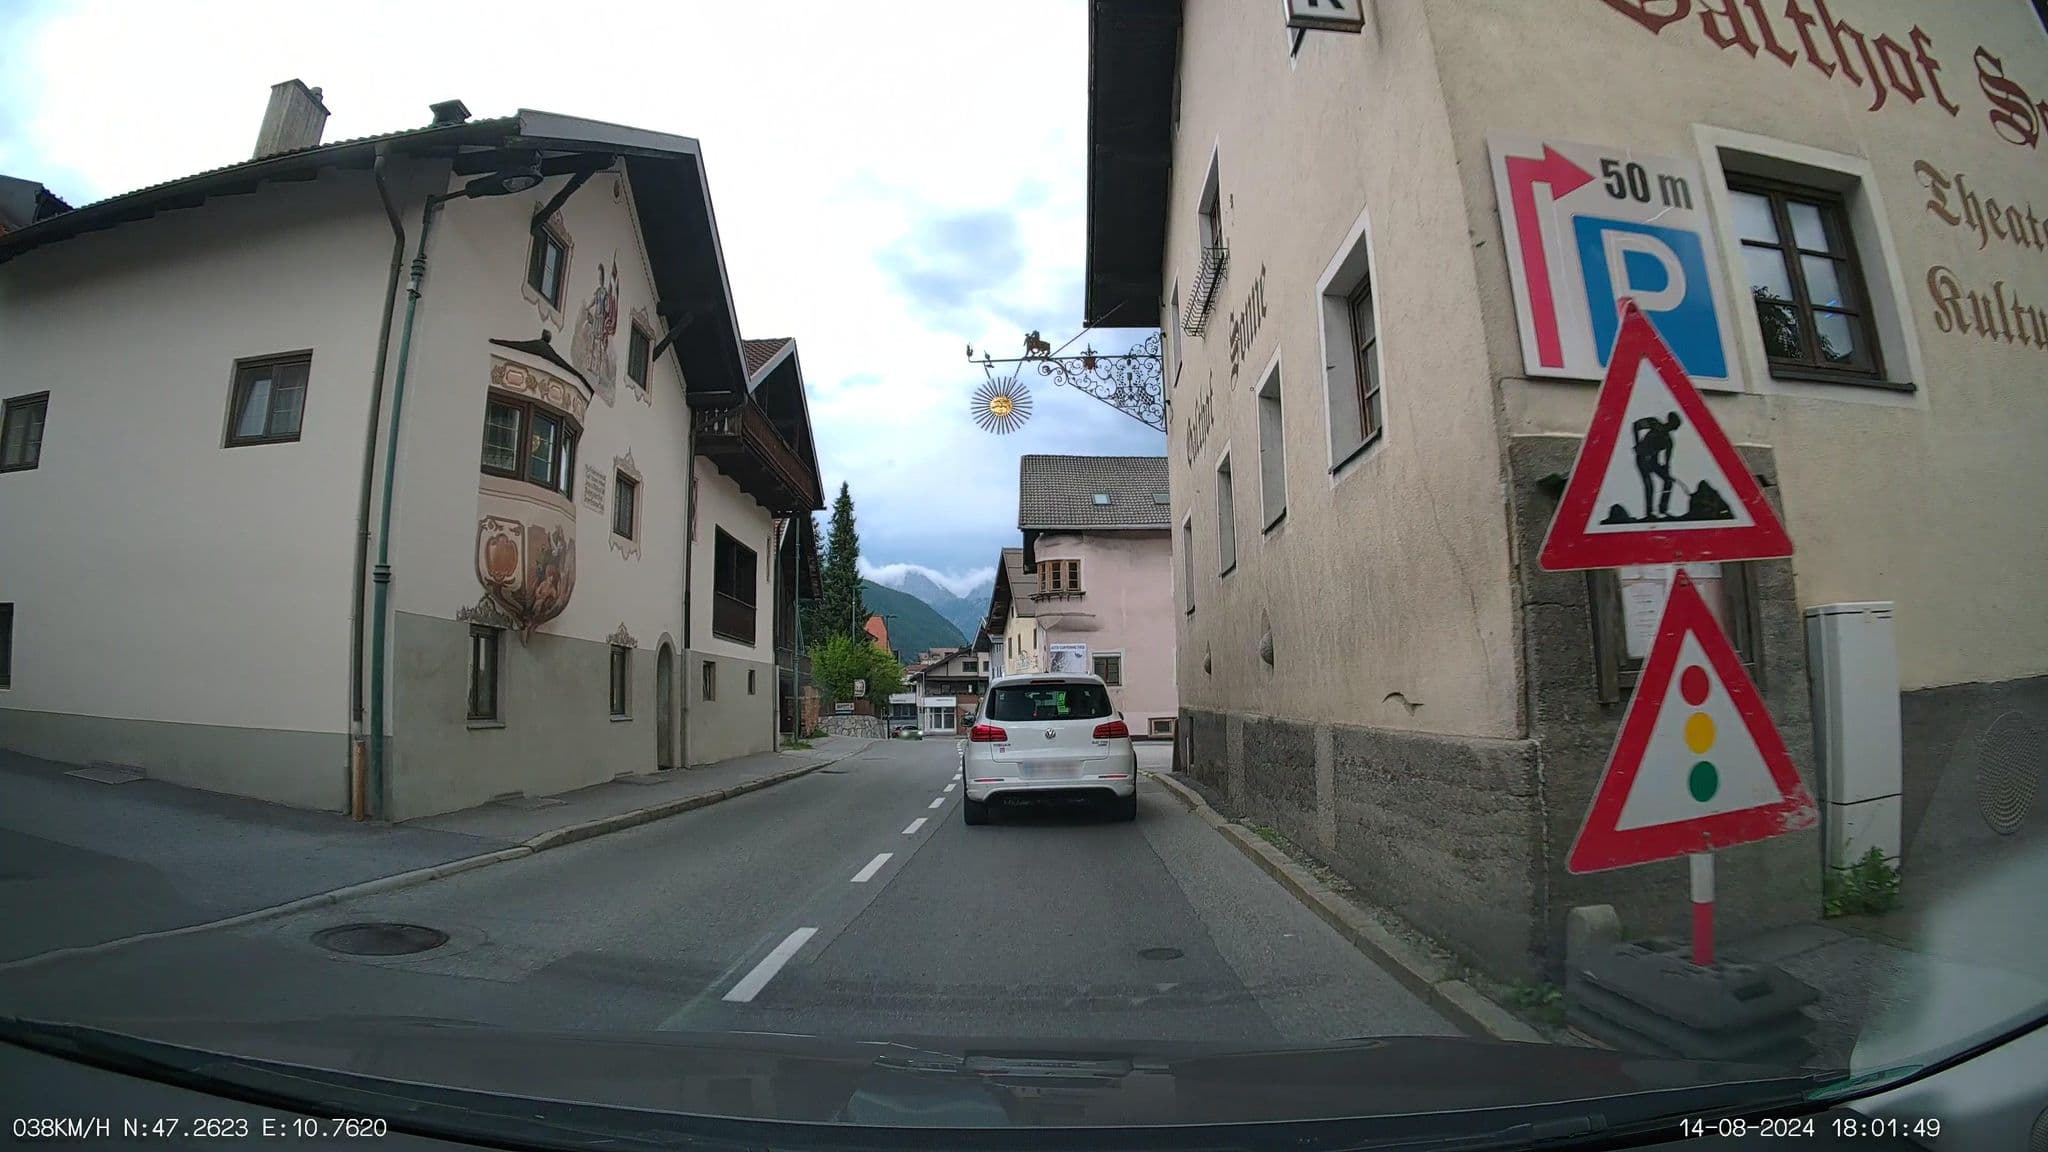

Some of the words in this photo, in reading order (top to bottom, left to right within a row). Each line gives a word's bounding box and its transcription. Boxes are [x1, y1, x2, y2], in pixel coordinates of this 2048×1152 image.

[1600, 158, 1651, 203] 50
[1658, 174, 1693, 210] m
[1600, 228, 1688, 312] P
